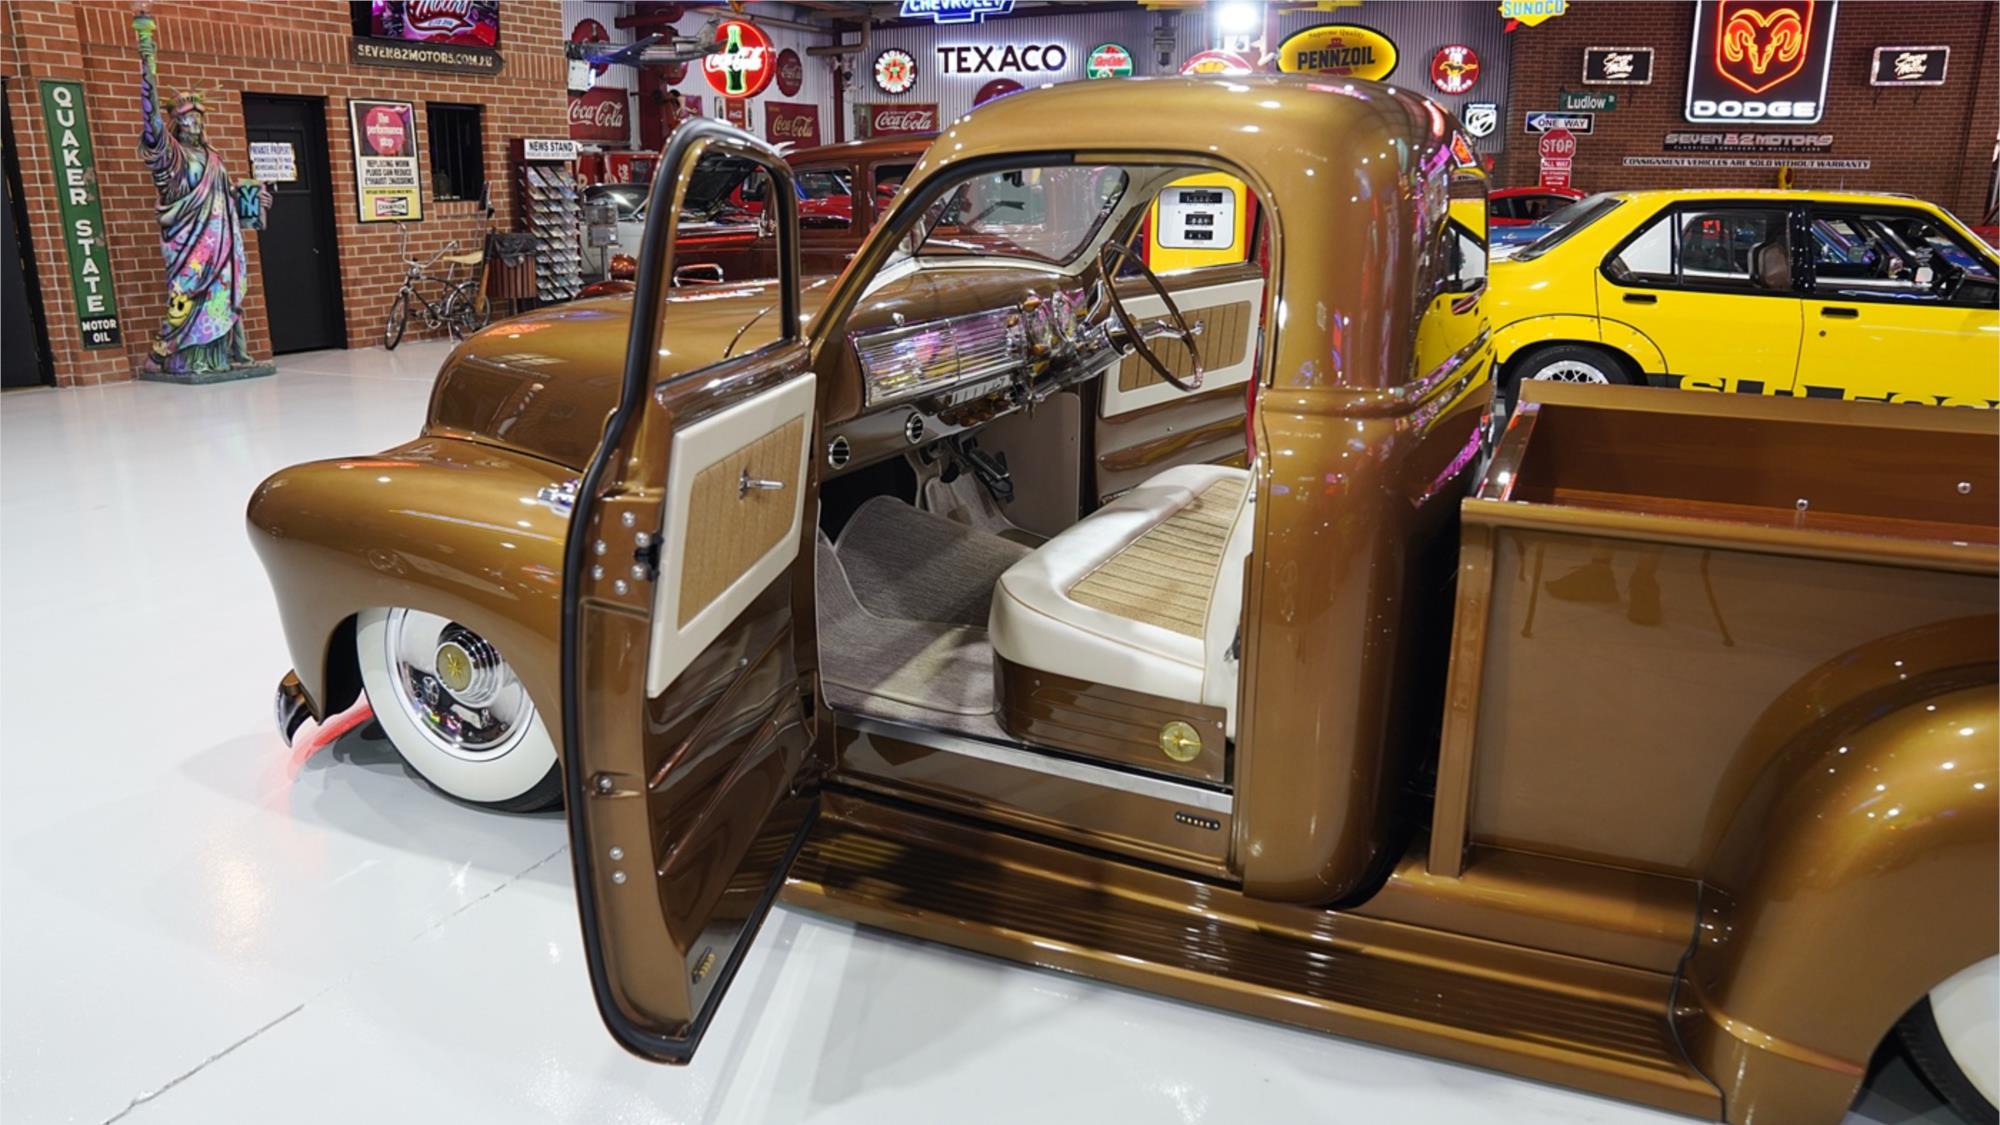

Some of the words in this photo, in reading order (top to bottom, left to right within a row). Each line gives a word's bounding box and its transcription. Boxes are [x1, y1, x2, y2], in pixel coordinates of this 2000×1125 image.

[1503, 0, 1564, 16] SUNOCO
[937, 45, 1067, 73] TEXACO
[1297, 46, 1376, 70] PENNZOIL
[1567, 95, 1606, 109] Ludlow
[1693, 101, 1817, 118] DODGE
[1564, 119, 1586, 127] WAY
[529, 142, 549, 152] NEWS
[550, 142, 574, 152] STAND
[1542, 139, 1574, 153] STOP
[53, 86, 87, 205] QUAKER
[75, 220, 105, 313] STATE
[82, 319, 117, 331] MOTOR
[93, 332, 111, 343] OIL
